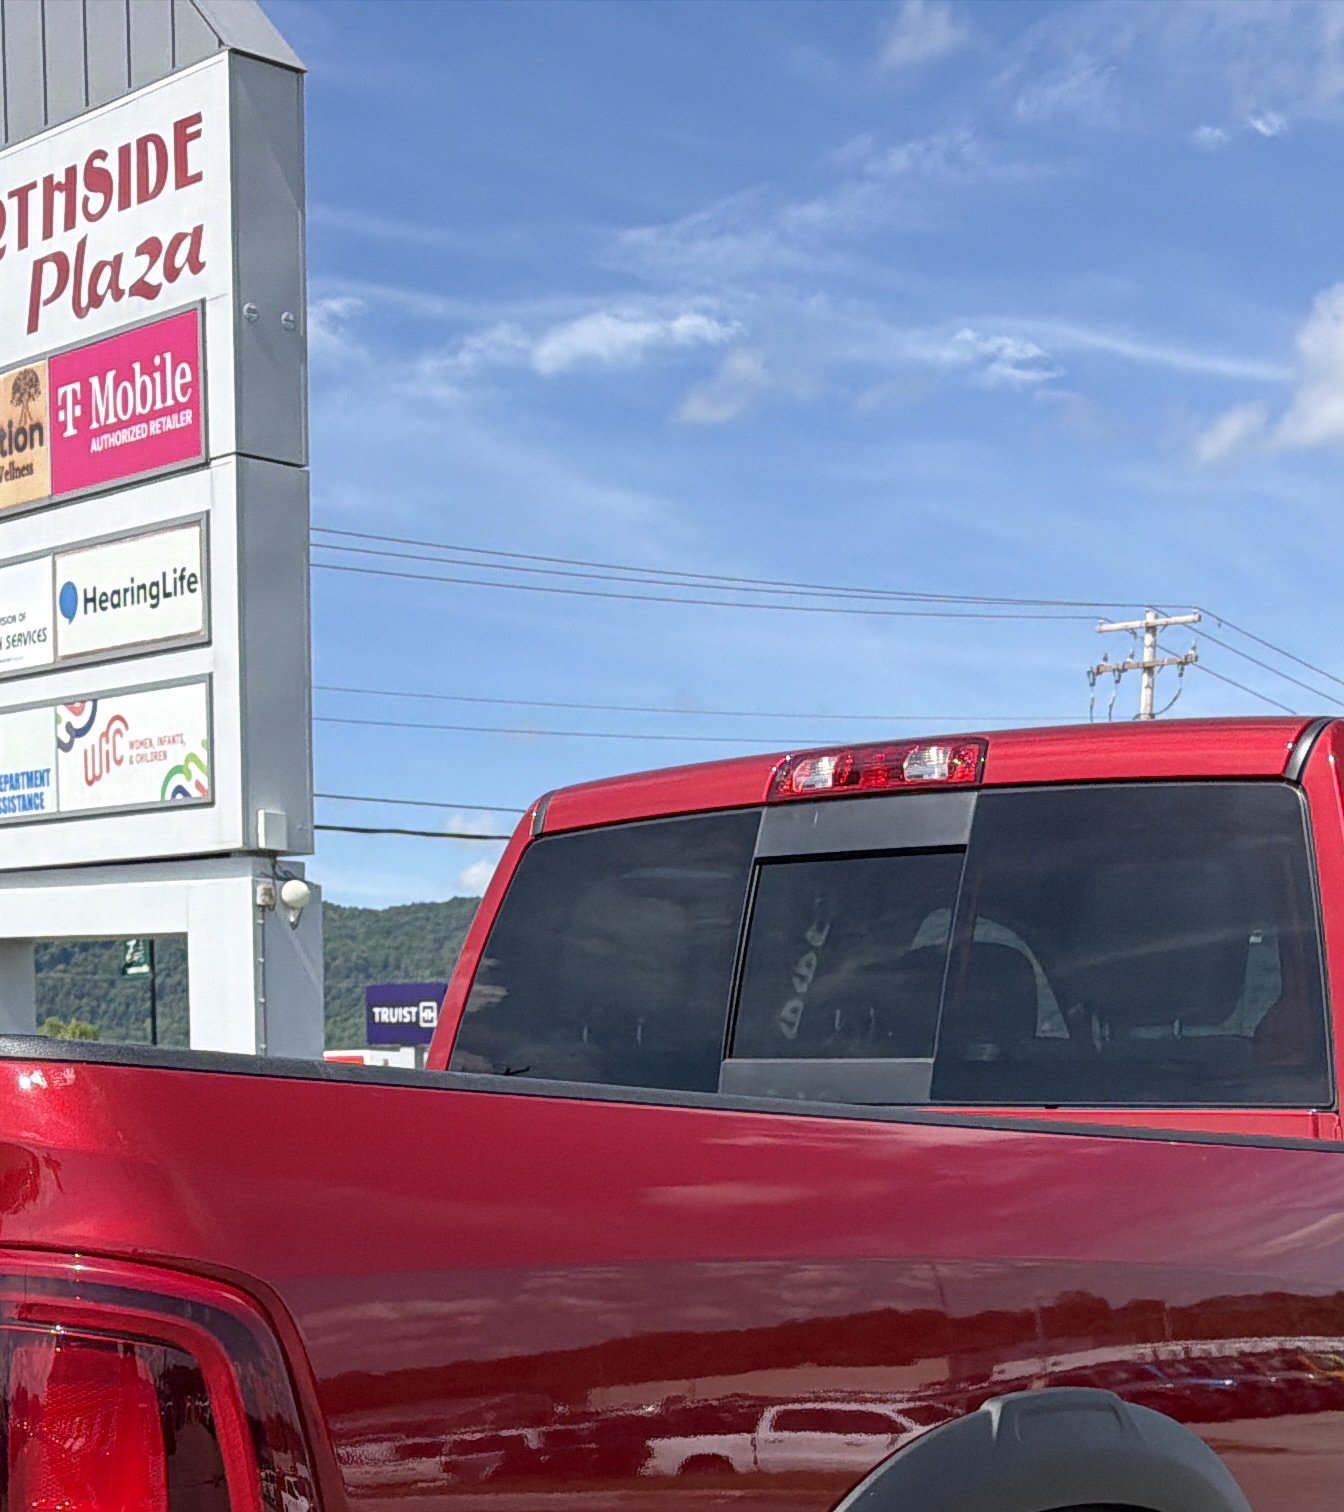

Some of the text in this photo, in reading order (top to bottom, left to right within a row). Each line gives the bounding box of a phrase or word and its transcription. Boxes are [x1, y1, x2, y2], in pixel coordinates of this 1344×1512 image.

[26, 223, 206, 336] Plaza
[88, 351, 193, 429] Mobile
[89, 408, 193, 454] AUTHORIZED RETAILER
[83, 567, 199, 615] HearingLife
[18, 611, 26, 623] OF
[5, 626, 48, 650] SERVICES
[136, 750, 167, 764] CHILDREN
[372, 1006, 419, 1024] TRUIST
